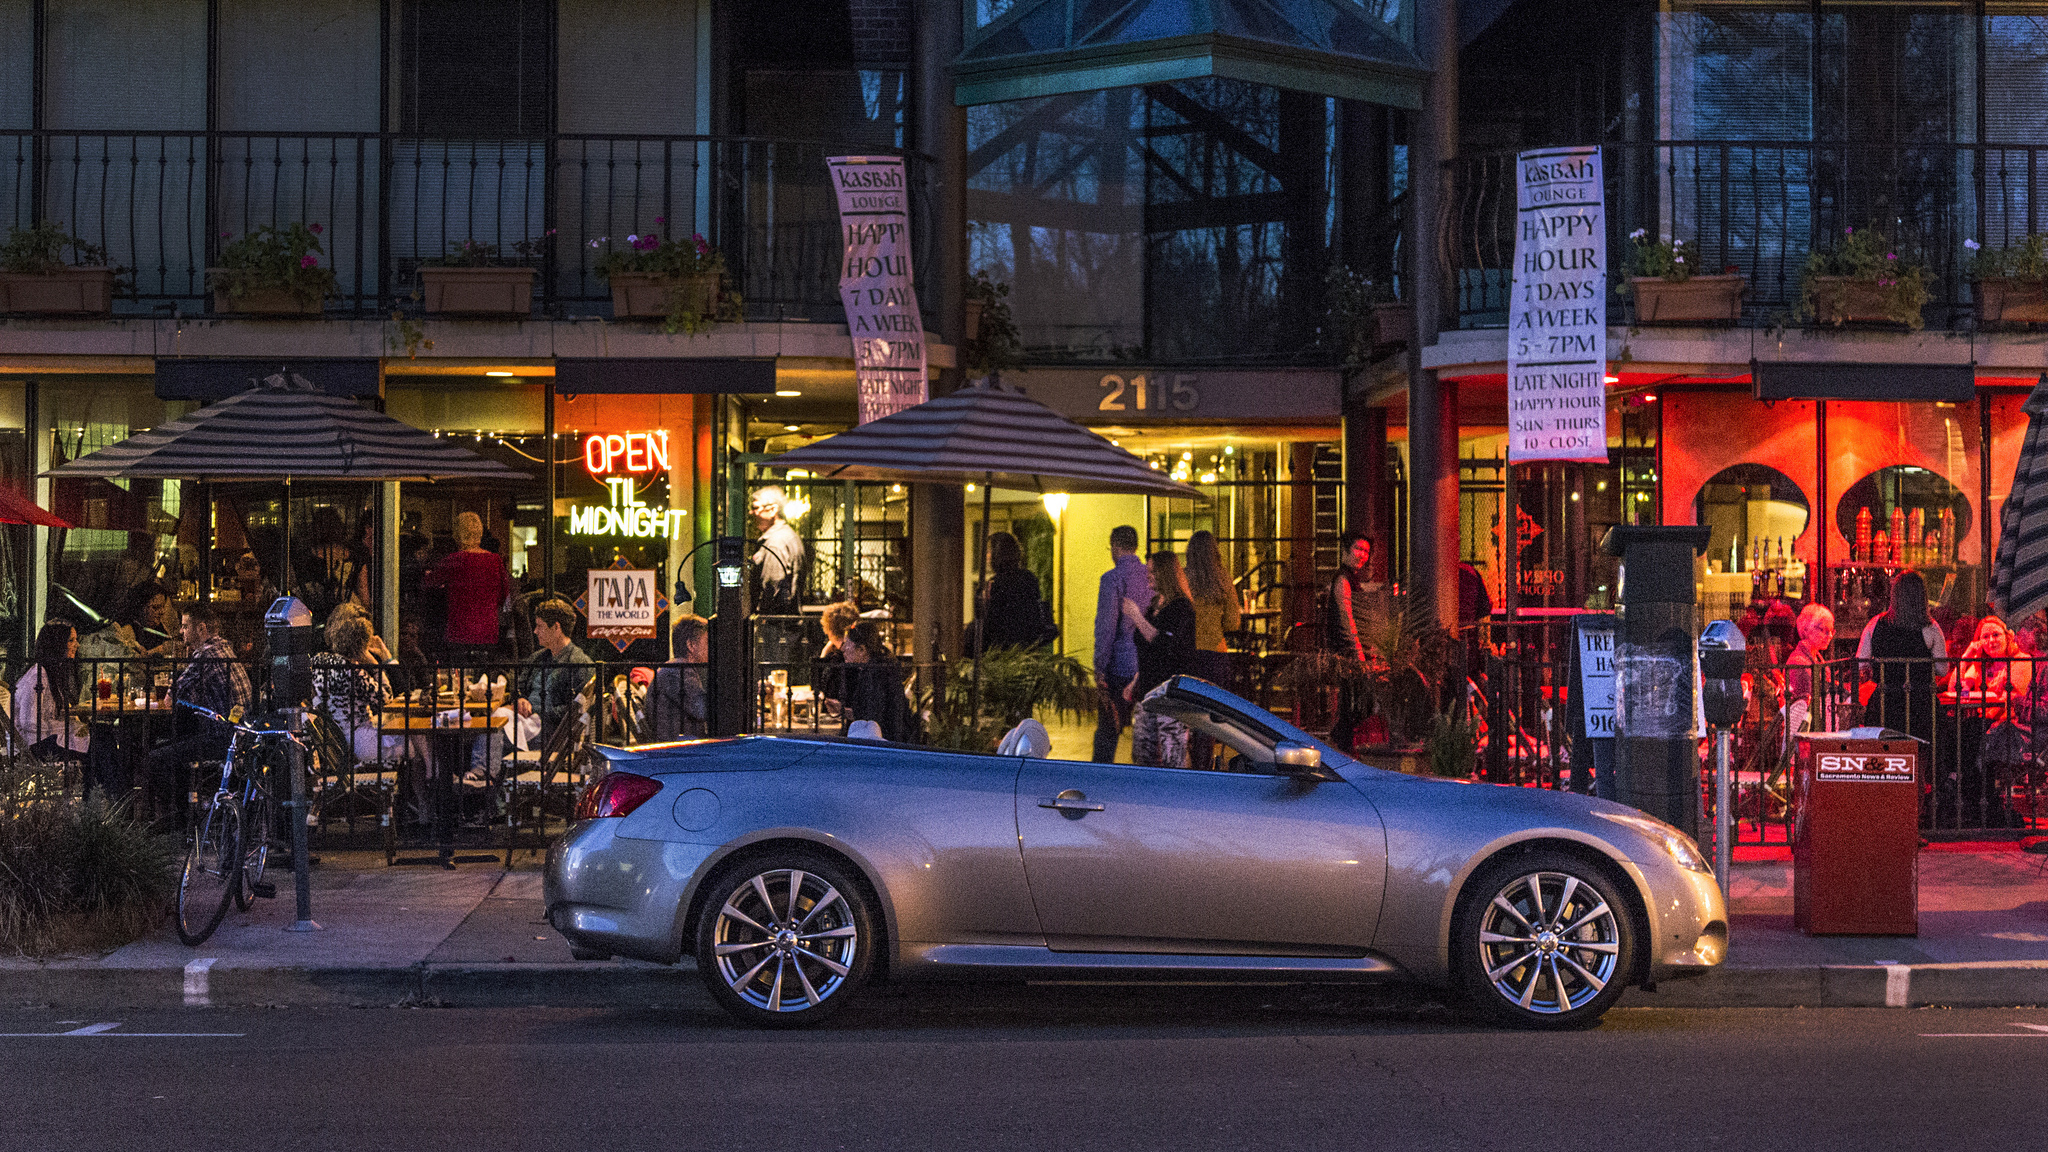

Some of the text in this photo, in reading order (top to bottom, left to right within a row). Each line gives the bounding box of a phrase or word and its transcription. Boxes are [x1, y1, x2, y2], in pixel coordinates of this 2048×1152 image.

[1532, 188, 1587, 203] OUNGE
[1522, 215, 1598, 241] HAPPY
[1524, 248, 1598, 273] HOUR
[850, 289, 860, 306] 7
[1525, 281, 1594, 301] 7 DAYS
[856, 314, 918, 333] A WEEK
[1517, 307, 1598, 329] A WEEK
[861, 341, 871, 359] 5
[888, 341, 920, 360] 7PM
[1517, 338, 1528, 356] 5
[1548, 334, 1595, 354] 7PM
[858, 379, 923, 395] LATE NIGHT
[1514, 372, 1600, 391] LATE NIGHT
[1099, 374, 1200, 411] 2115
[1515, 396, 1601, 411] HAPPY HOUR
[1516, 420, 1543, 432] SUN
[1554, 417, 1600, 430] THURS
[1524, 438, 1538, 450] 10
[1549, 435, 1592, 448] CLOSE
[586, 433, 671, 473] OPEN
[605, 477, 647, 508] TIL
[570, 505, 688, 541] MIDNIGHT
[594, 574, 650, 610] TAPA
[597, 610, 650, 619] THE WORLD
